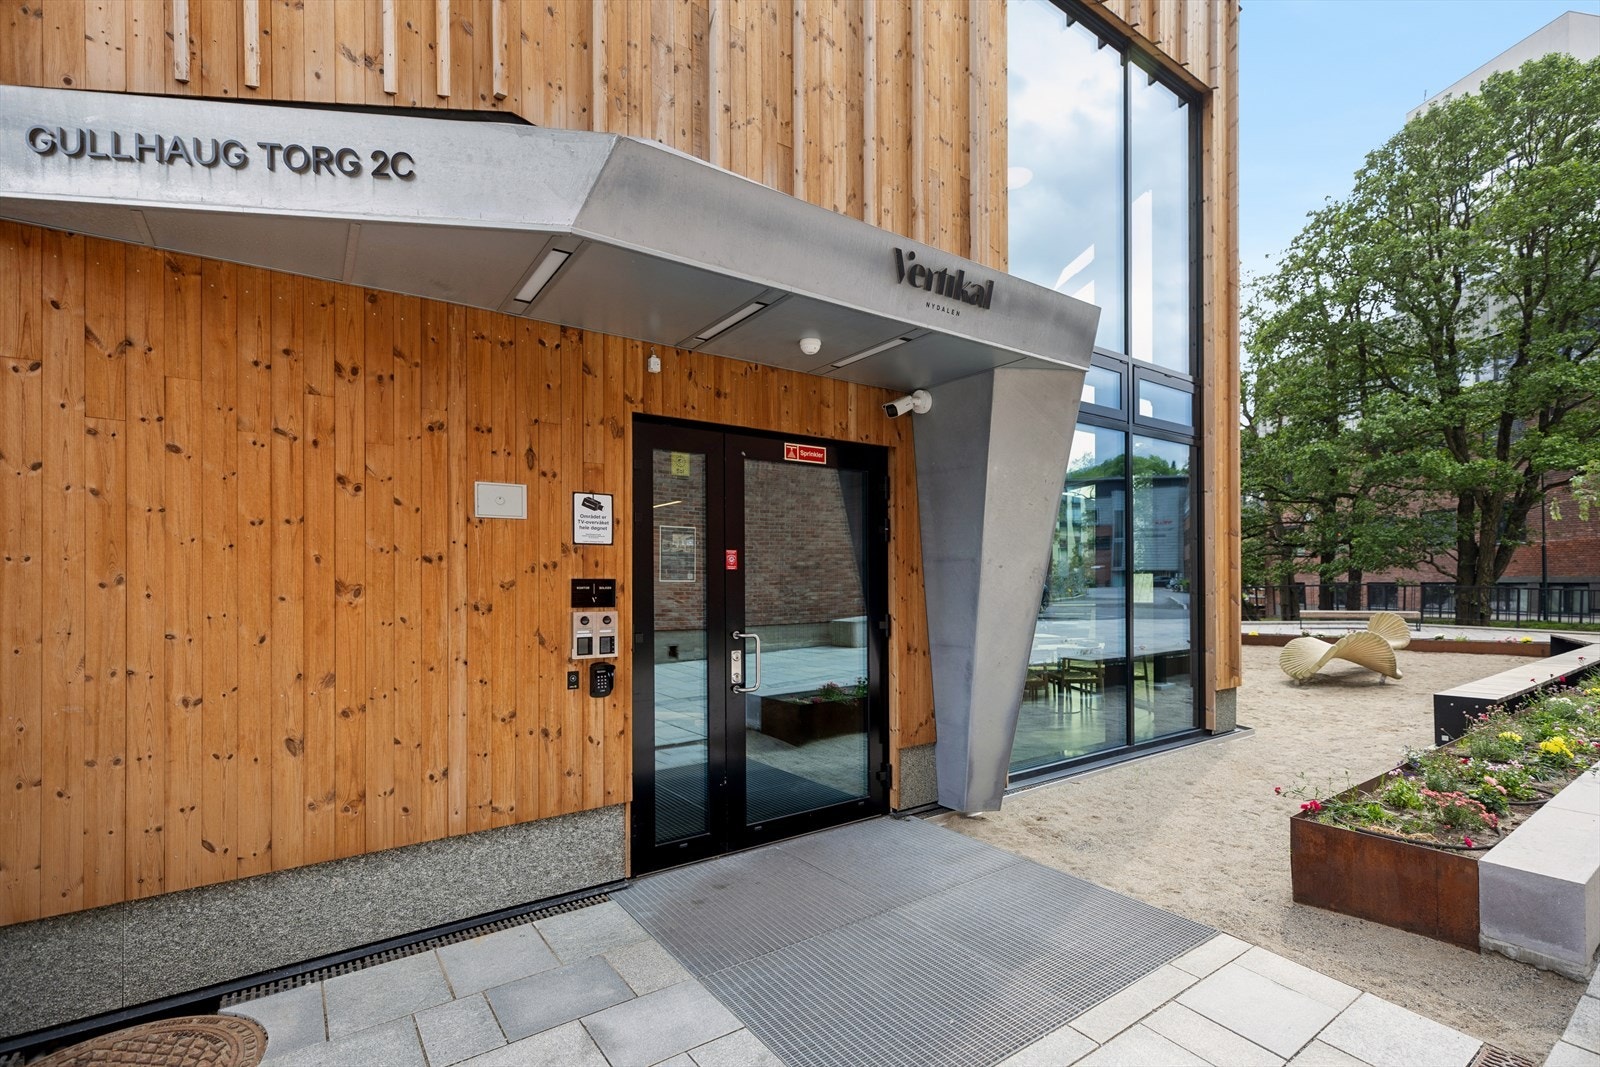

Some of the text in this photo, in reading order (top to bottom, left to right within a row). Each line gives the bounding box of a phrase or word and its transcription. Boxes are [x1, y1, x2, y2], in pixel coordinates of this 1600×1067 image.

[25, 124, 416, 181] GULLHAUG TORG 2C
[893, 247, 994, 310] Vertikal
[925, 302, 961, 317] NYDALEN
[800, 450, 824, 458] Sprinkler
